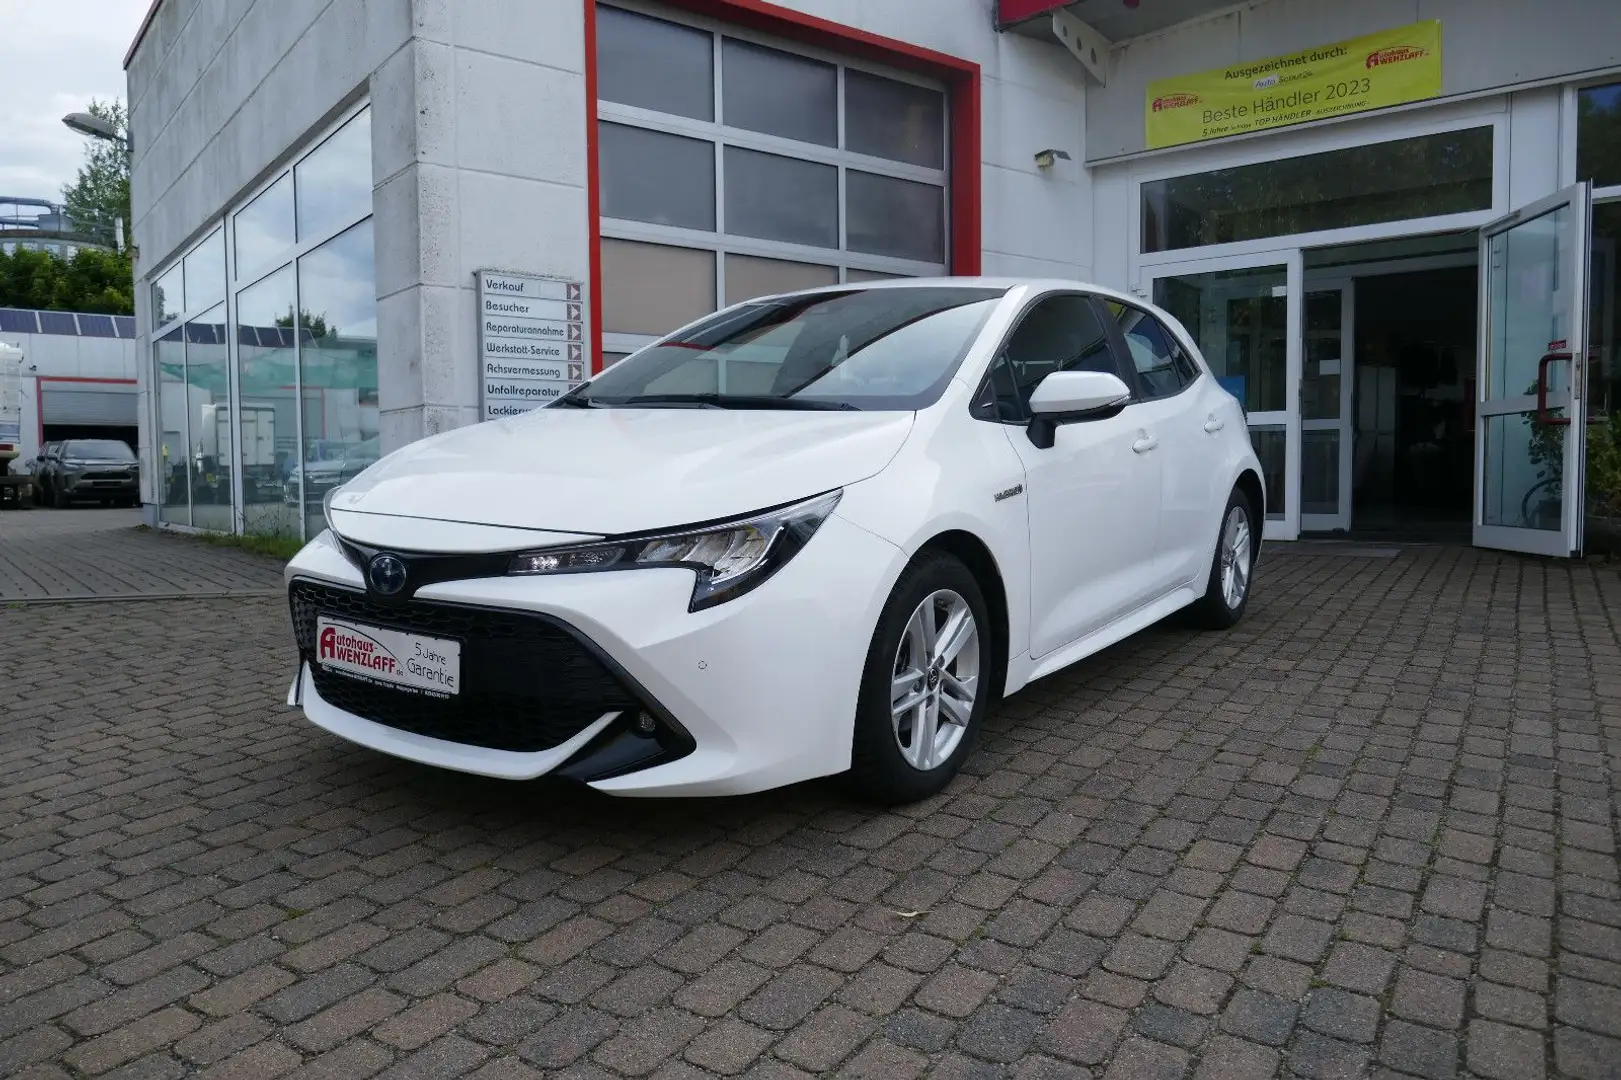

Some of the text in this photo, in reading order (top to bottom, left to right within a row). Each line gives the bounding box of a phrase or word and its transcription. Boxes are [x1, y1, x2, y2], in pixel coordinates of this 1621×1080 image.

[1224, 46, 1348, 81] Ausgezeichnet durch:
[1202, 77, 1370, 124] Beste Händler 2023
[1202, 128, 1208, 137] 5
[486, 279, 524, 292] Verkauf
[486, 300, 529, 313] Besucher
[486, 321, 564, 337] Reparaturannahme
[486, 342, 560, 356] Werkstatt-Service
[487, 363, 561, 378] Achsvermessung
[487, 384, 560, 397] Unfallreparatur
[336, 646, 396, 673] WENZLAFF
[415, 642, 447, 665] 5 Jahre
[407, 657, 454, 688] Garantie
